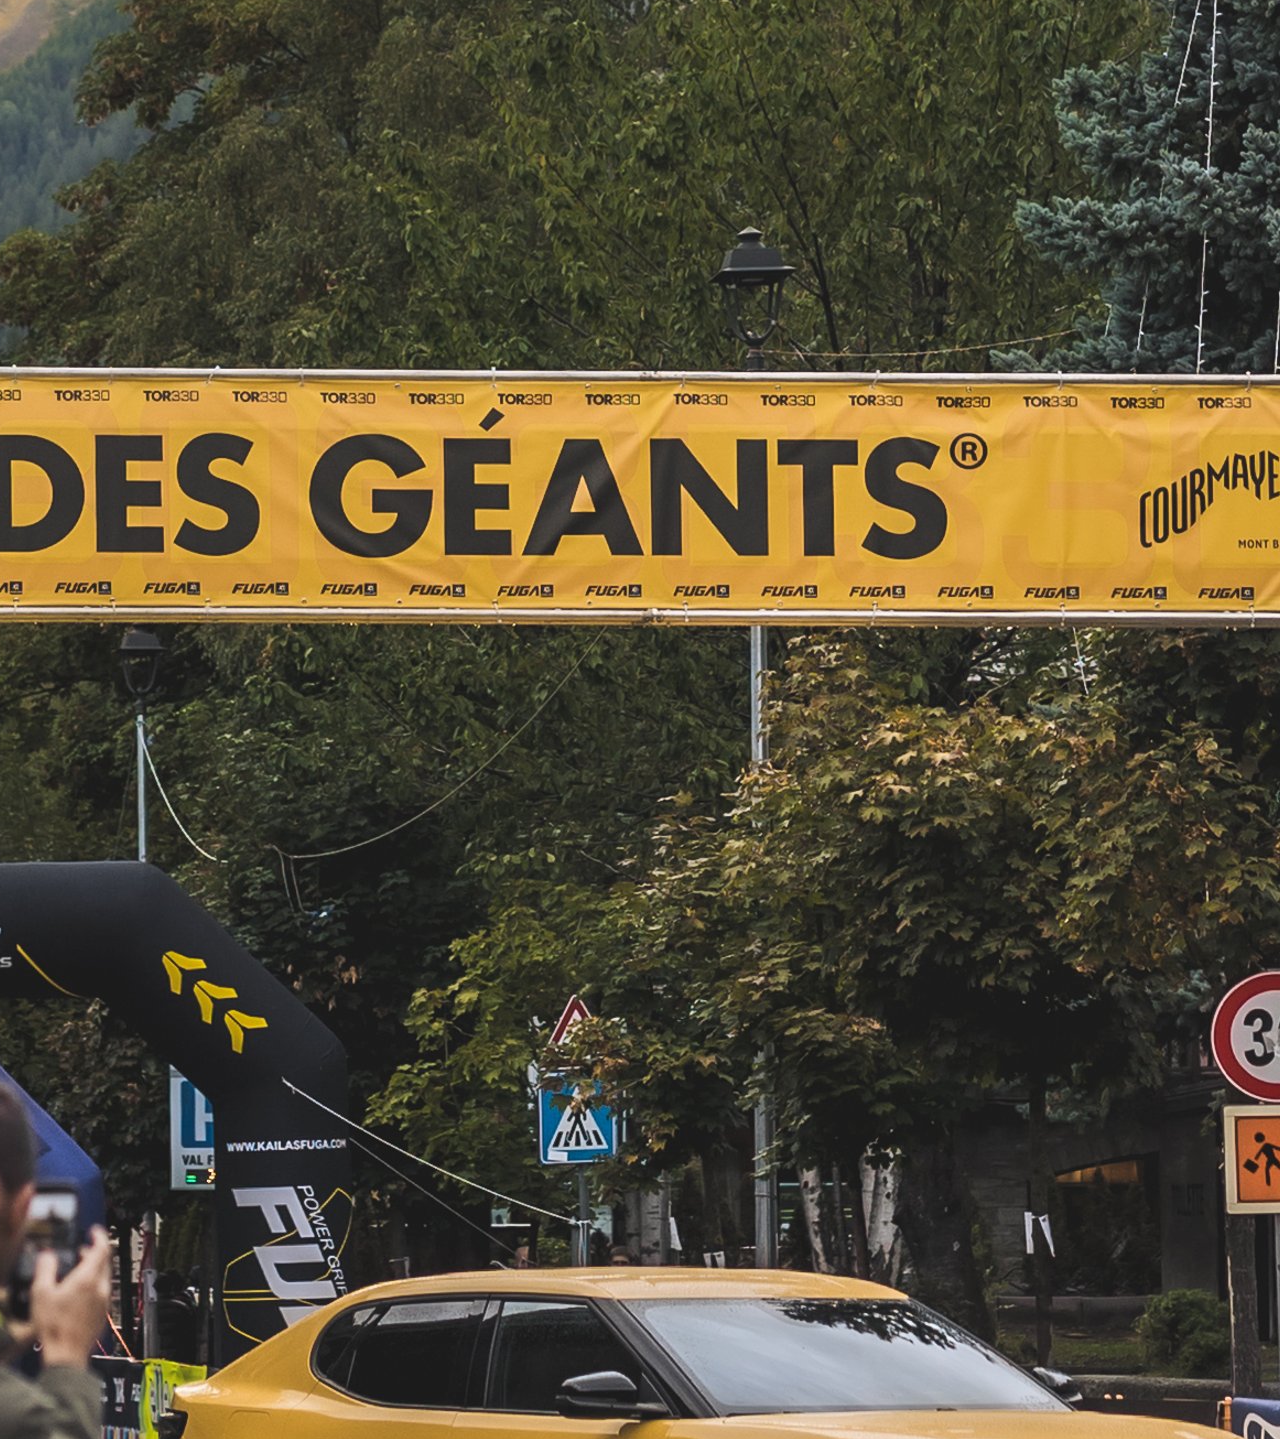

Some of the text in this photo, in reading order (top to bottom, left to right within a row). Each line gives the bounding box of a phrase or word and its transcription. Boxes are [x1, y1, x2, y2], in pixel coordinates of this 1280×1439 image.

[54, 388, 110, 403] TOR330
[142, 390, 199, 402] TOR330
[232, 390, 287, 403] TOR330
[319, 392, 376, 405] TOR330
[408, 392, 465, 405] TOR330
[496, 393, 553, 406] TOR330
[584, 393, 641, 406] TOR330
[673, 392, 728, 406] TOR330
[760, 394, 816, 407] TOR330
[848, 393, 903, 407] TOR330
[935, 396, 991, 409] TOR330
[1022, 394, 1078, 409] TOR330
[1110, 396, 1165, 410] TOR330
[1197, 396, 1252, 410] TOR330
[1238, 539, 1269, 549] MONT
[54, 582, 98, 596] FUGA
[143, 582, 187, 596] FUGA
[231, 583, 275, 596] FUGA
[320, 583, 364, 597] FUGA
[408, 584, 452, 598] FUGA
[497, 585, 540, 598] FUGA
[585, 585, 628, 598] FUGA
[673, 585, 716, 599] FUGA
[761, 585, 804, 599] FUGA
[849, 586, 892, 599] FUGA
[937, 586, 980, 600] FUGA
[1024, 587, 1066, 600] FUGA
[1111, 587, 1154, 600] FUGA
[1198, 587, 1241, 601] FUGA
[226, 1138, 347, 1153] WWW.KAILASFUGA.COM
[182, 1154, 203, 1167] VAL
[297, 1185, 336, 1251] POWER
